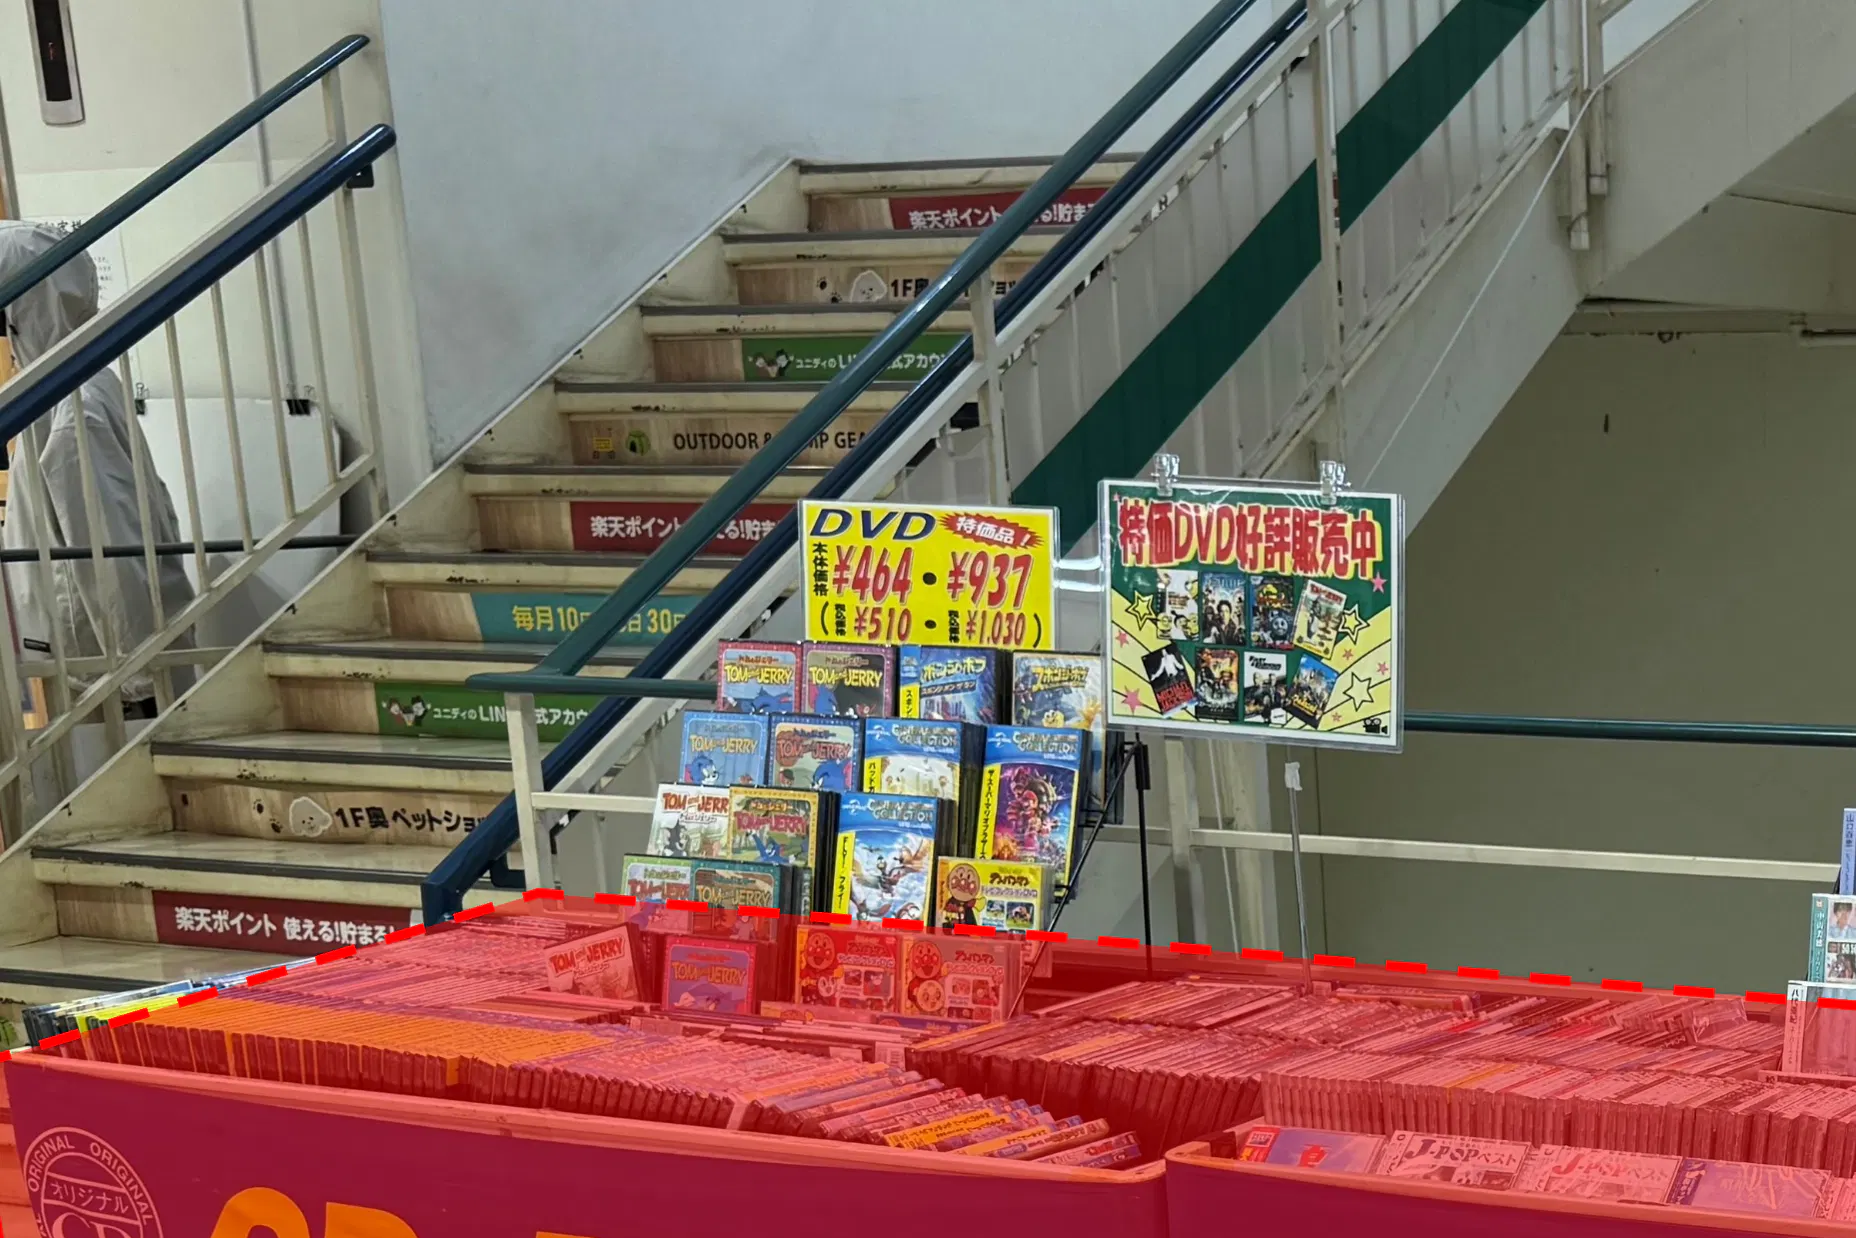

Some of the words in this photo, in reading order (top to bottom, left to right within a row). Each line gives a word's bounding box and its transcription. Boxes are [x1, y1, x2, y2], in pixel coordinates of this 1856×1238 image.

[673, 432, 759, 450] OUTDOOR
[810, 508, 937, 541] DVD
[1119, 497, 1382, 579] 特価DVD好評販売中
[812, 542, 829, 597] 本体価格
[724, 666, 748, 682] TOM
[758, 667, 793, 685] JERRY
[809, 667, 834, 684] TOM
[844, 668, 883, 687] JERRY
[691, 735, 713, 752] TOM
[723, 737, 758, 754] JERRY
[663, 793, 687, 811] TOM
[698, 796, 729, 812] JERR
[335, 806, 389, 828] 1F奥
[696, 885, 722, 904] TOM
[732, 888, 771, 907] JERRY
[175, 906, 277, 938] 楽天ポイント
[549, 952, 576, 974] TOM
[585, 937, 624, 965] JERRY
[671, 961, 699, 980] TOM
[707, 963, 748, 986] JERRY
[49, 1180, 130, 1215] オリジナル
